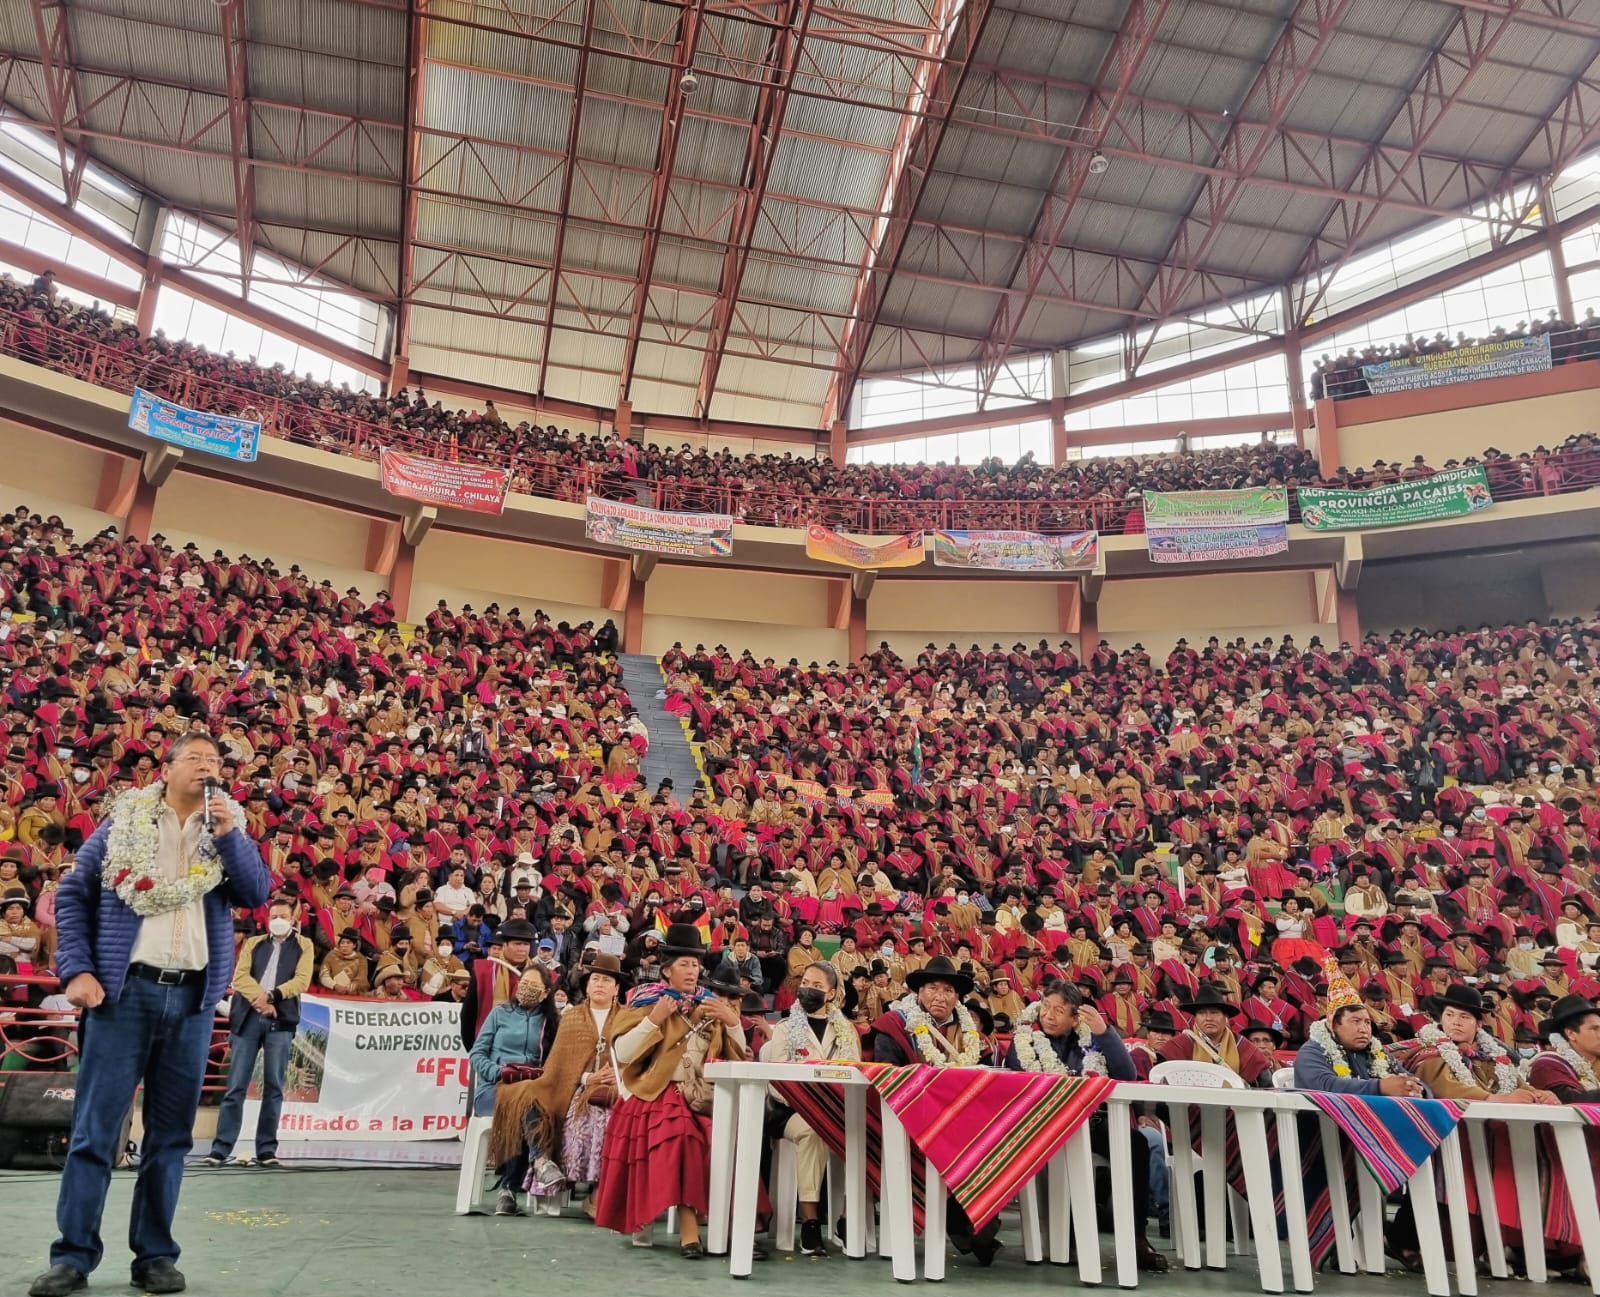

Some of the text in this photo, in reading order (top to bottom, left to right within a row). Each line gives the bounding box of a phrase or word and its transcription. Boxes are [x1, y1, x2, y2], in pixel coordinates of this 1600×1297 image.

[1459, 343, 1502, 358] ORIGINARIO
[1504, 338, 1525, 350] URUS
[1457, 364, 1488, 375] PROVINCIA
[1432, 468, 1481, 483] SINDICAL
[464, 491, 500, 504] CHILAYA
[1319, 483, 1463, 509] PROVINCIA PACAJES
[1154, 552, 1190, 561] PROVINCIA
[335, 1009, 443, 1026] FEDERACION
[355, 1034, 463, 1051] CAMPESINOS
[279, 1113, 360, 1132] filiado
[368, 1118, 383, 1131] a
[392, 1115, 414, 1132] la
